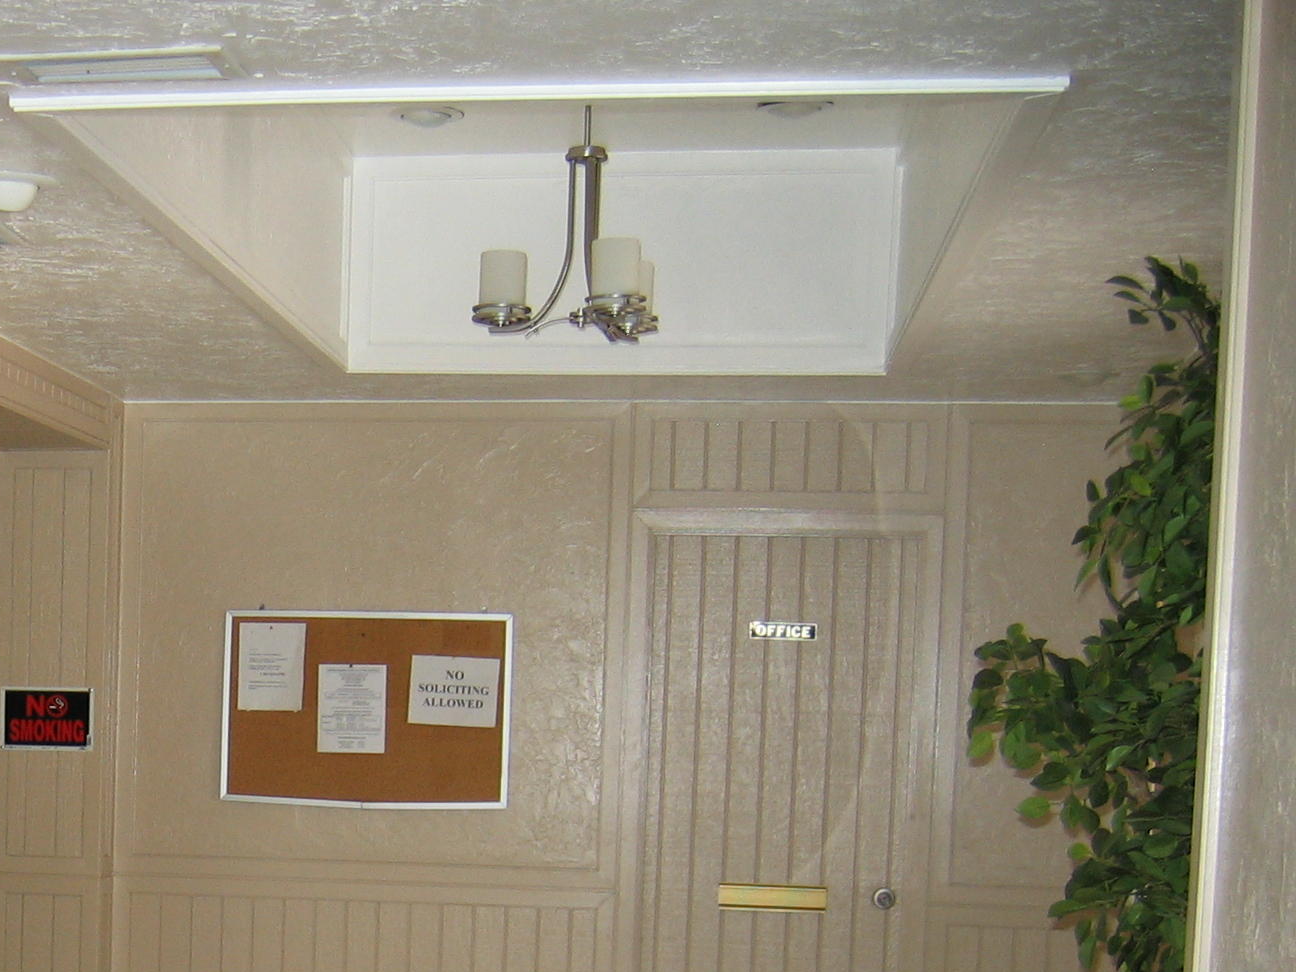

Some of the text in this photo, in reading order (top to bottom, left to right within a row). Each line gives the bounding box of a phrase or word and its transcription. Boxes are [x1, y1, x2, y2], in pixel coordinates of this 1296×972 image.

[755, 624, 811, 638] OFFICE
[445, 670, 465, 681] NO
[417, 683, 490, 696] SOLICITING
[422, 697, 484, 709] ALLOWED
[9, 719, 85, 743] SMOKING
